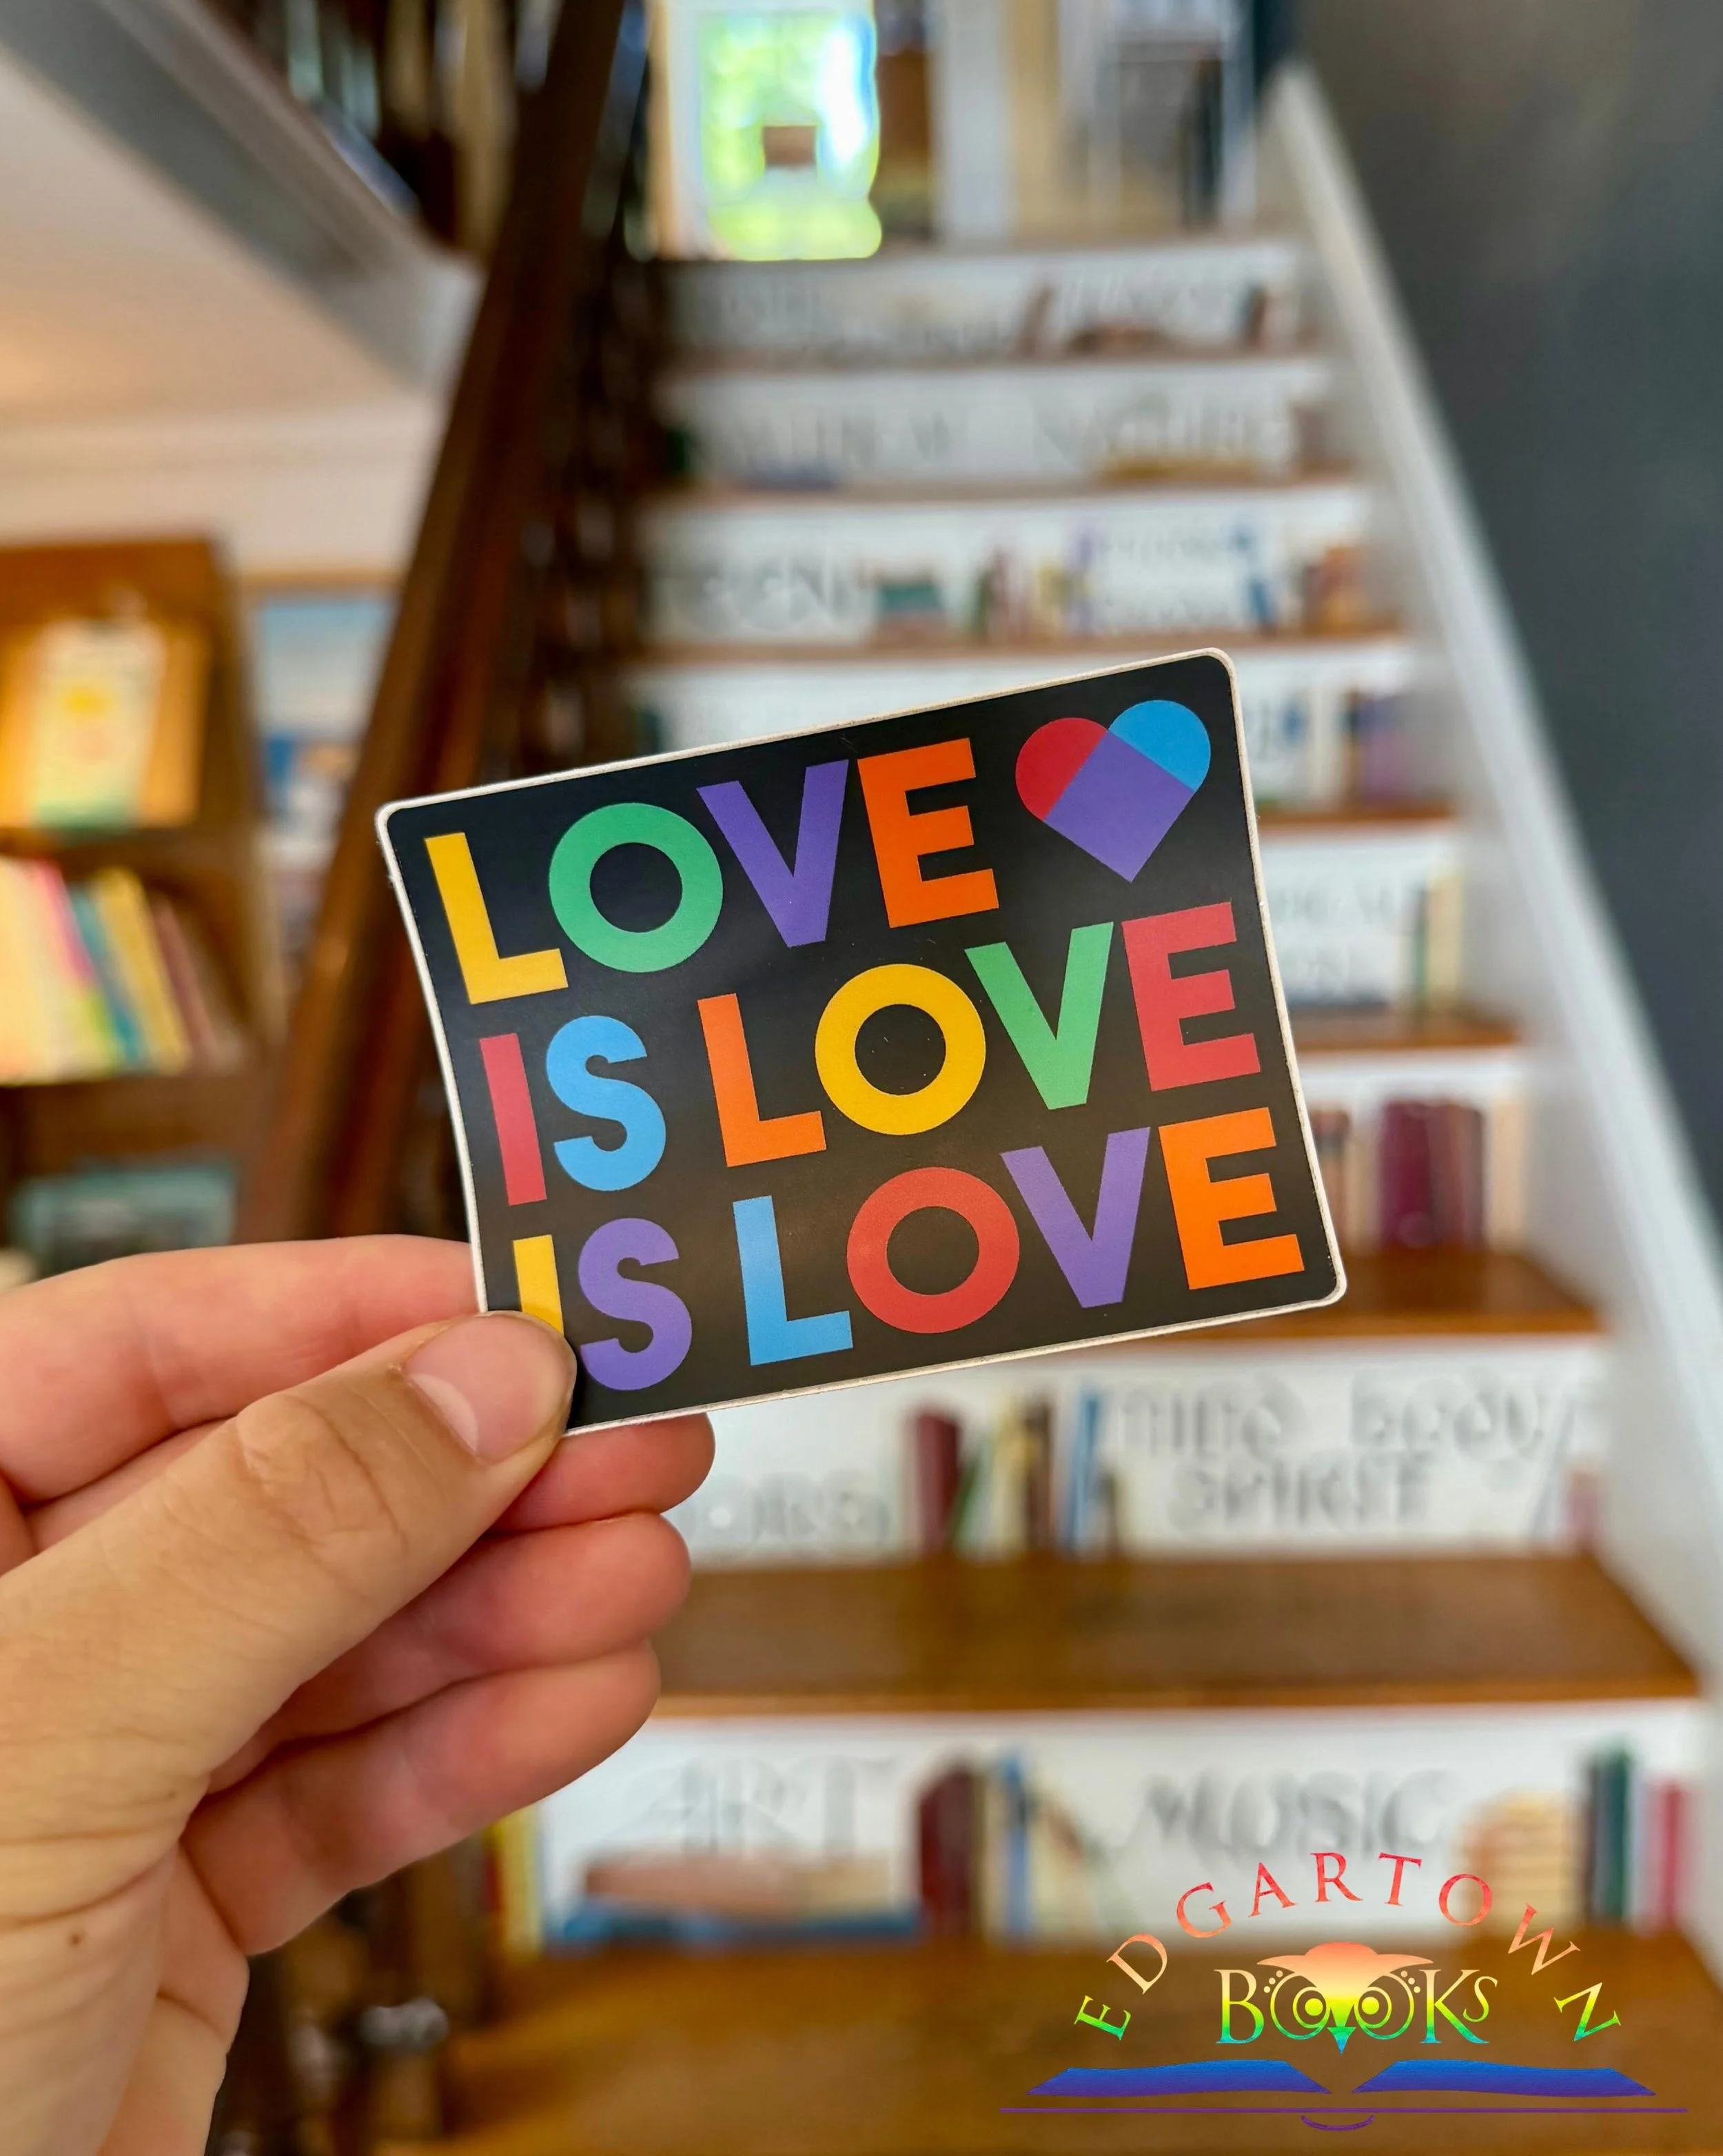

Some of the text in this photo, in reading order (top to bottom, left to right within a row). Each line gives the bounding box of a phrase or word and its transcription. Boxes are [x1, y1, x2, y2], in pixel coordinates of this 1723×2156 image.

[424, 738, 999, 1005] LOVE
[477, 901, 1262, 1207] IS LOVE
[732, 1106, 1305, 1366] LOVE
[1120, 1763, 1456, 1854] MUSIC
